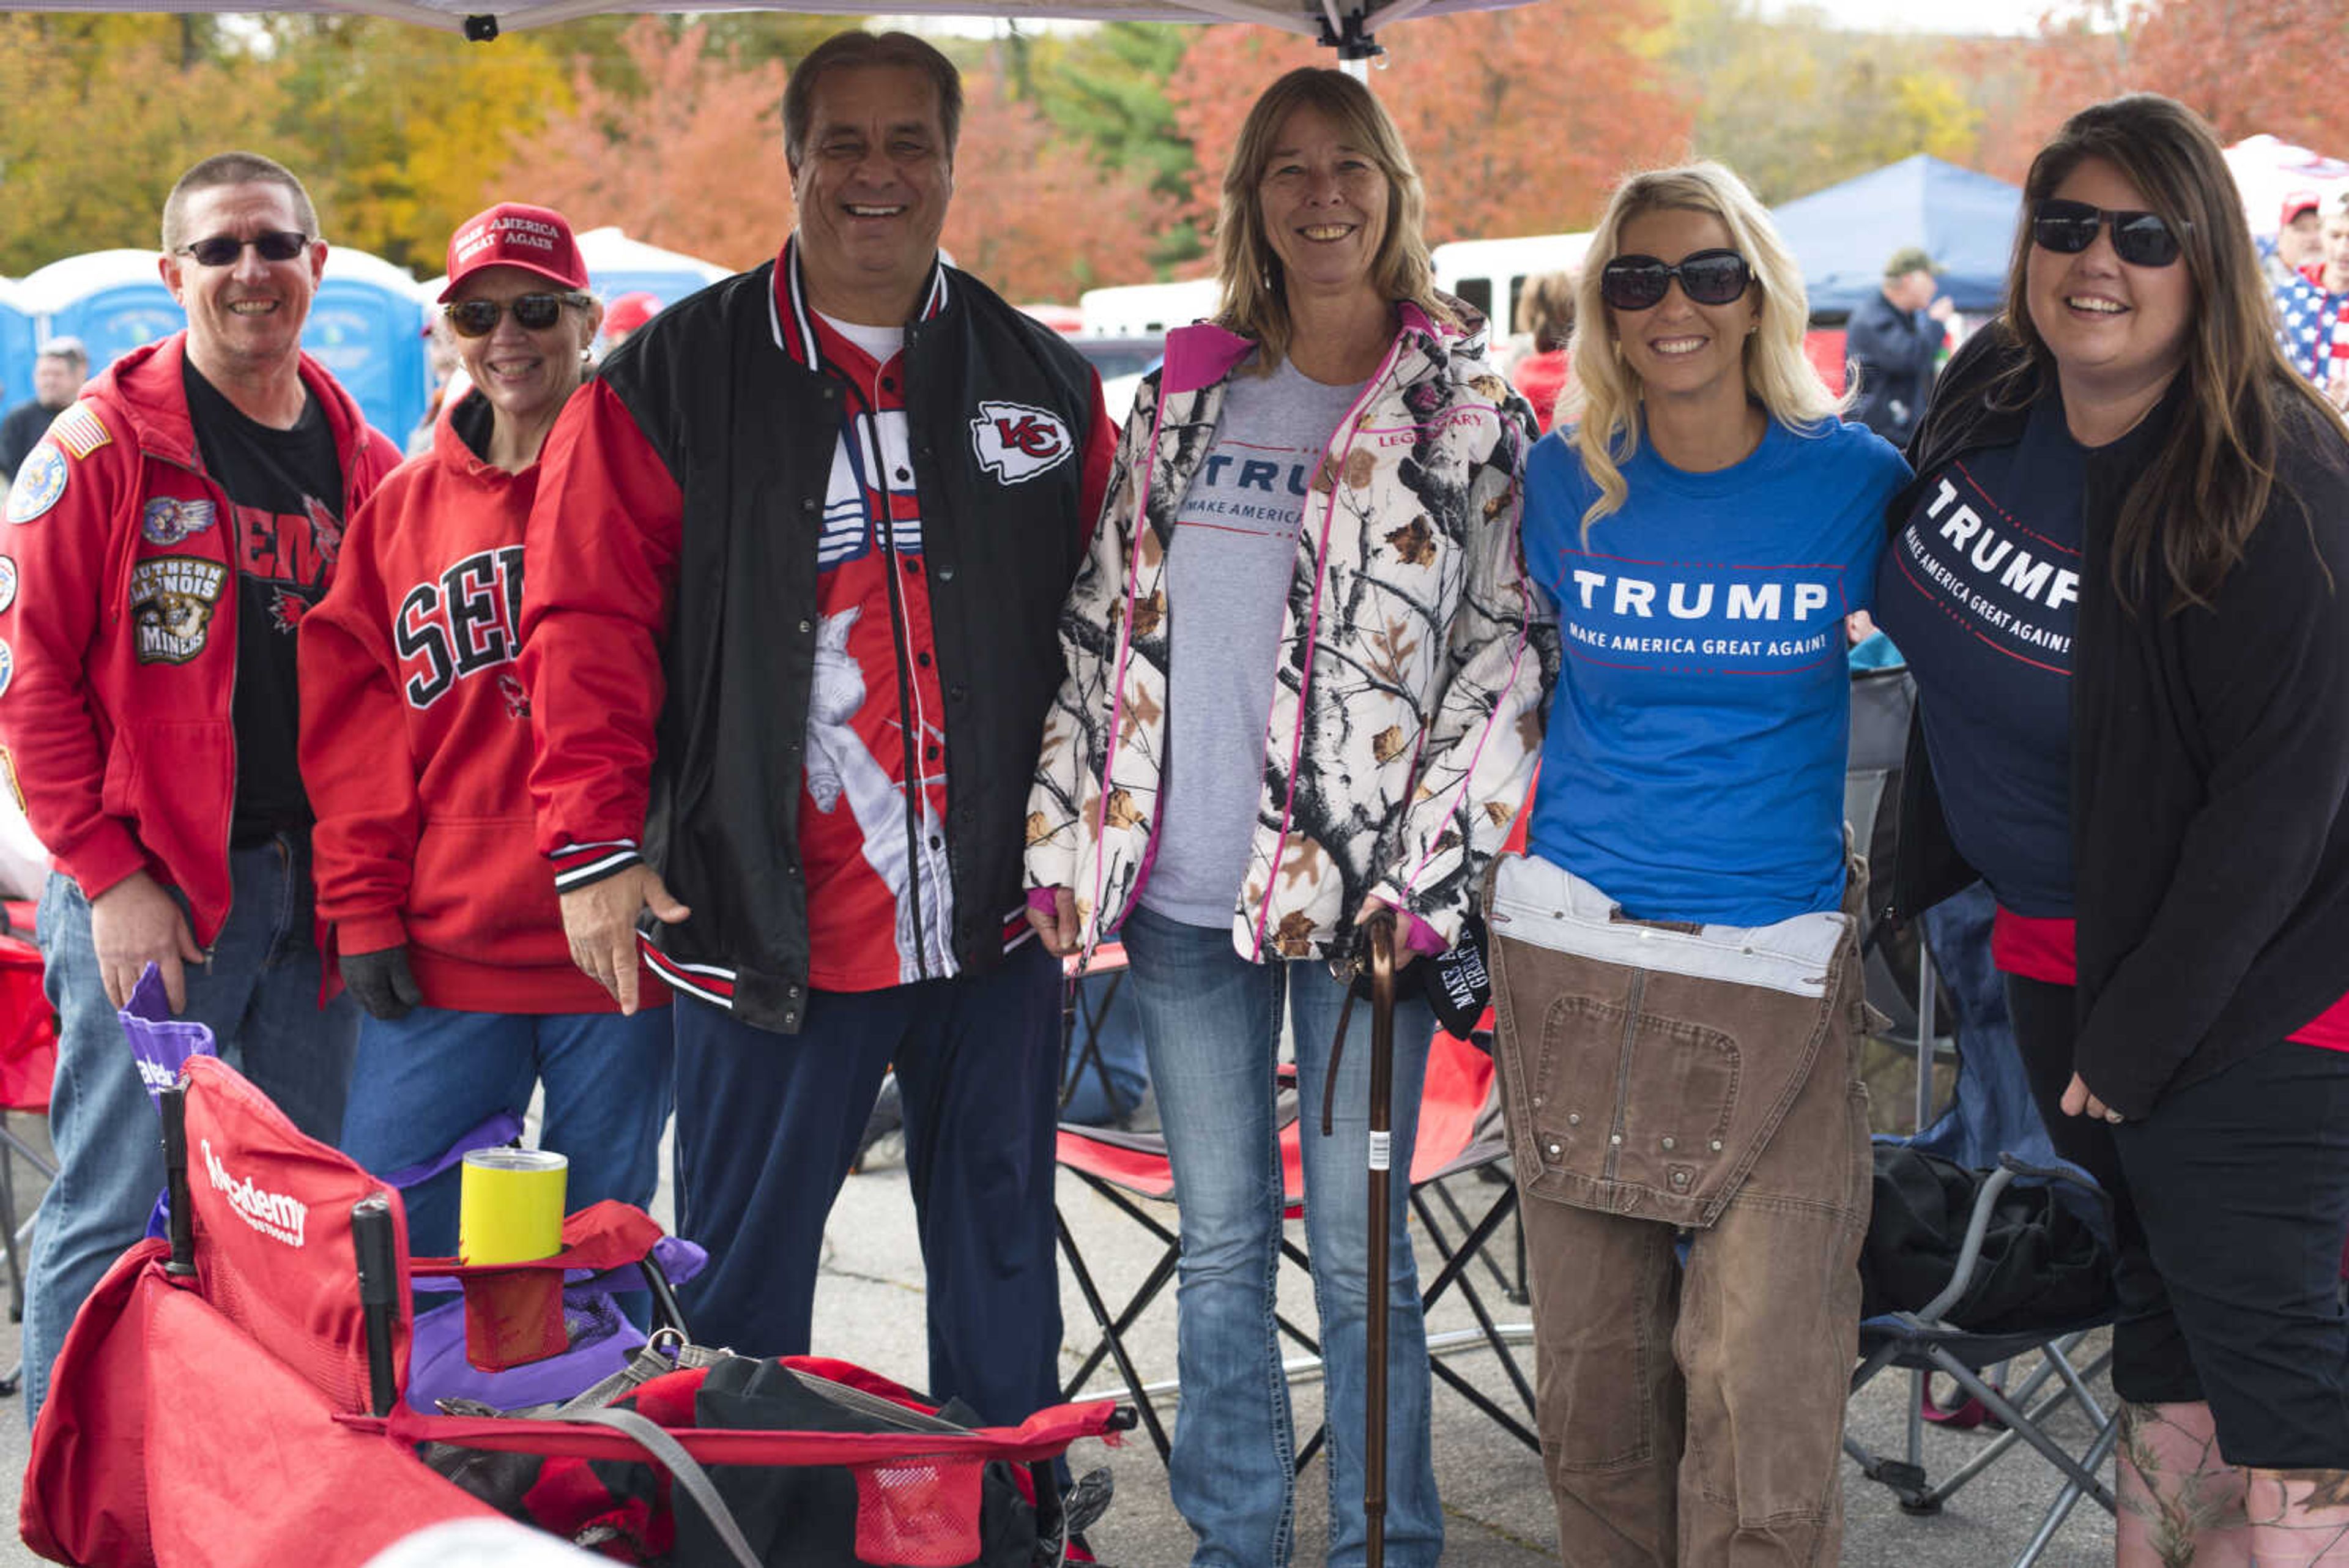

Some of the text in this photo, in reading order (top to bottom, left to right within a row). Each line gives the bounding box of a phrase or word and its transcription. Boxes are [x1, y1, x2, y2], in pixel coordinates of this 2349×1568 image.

[490, 217, 559, 239] AMERICA
[505, 232, 552, 251] AGAIN
[994, 415, 1062, 459] KC
[1187, 500, 1227, 513] MAKE
[1573, 569, 1828, 620] TRUMP
[1904, 524, 2071, 653] MAKE AMERICA GREAT AGAIN!
[1570, 622, 1606, 647] MAKE
[1611, 636, 1696, 653] AMERICA
[1702, 639, 1762, 656] GREAT
[1442, 966, 1476, 1010] MAKE
[1457, 945, 1488, 989] GREAT
